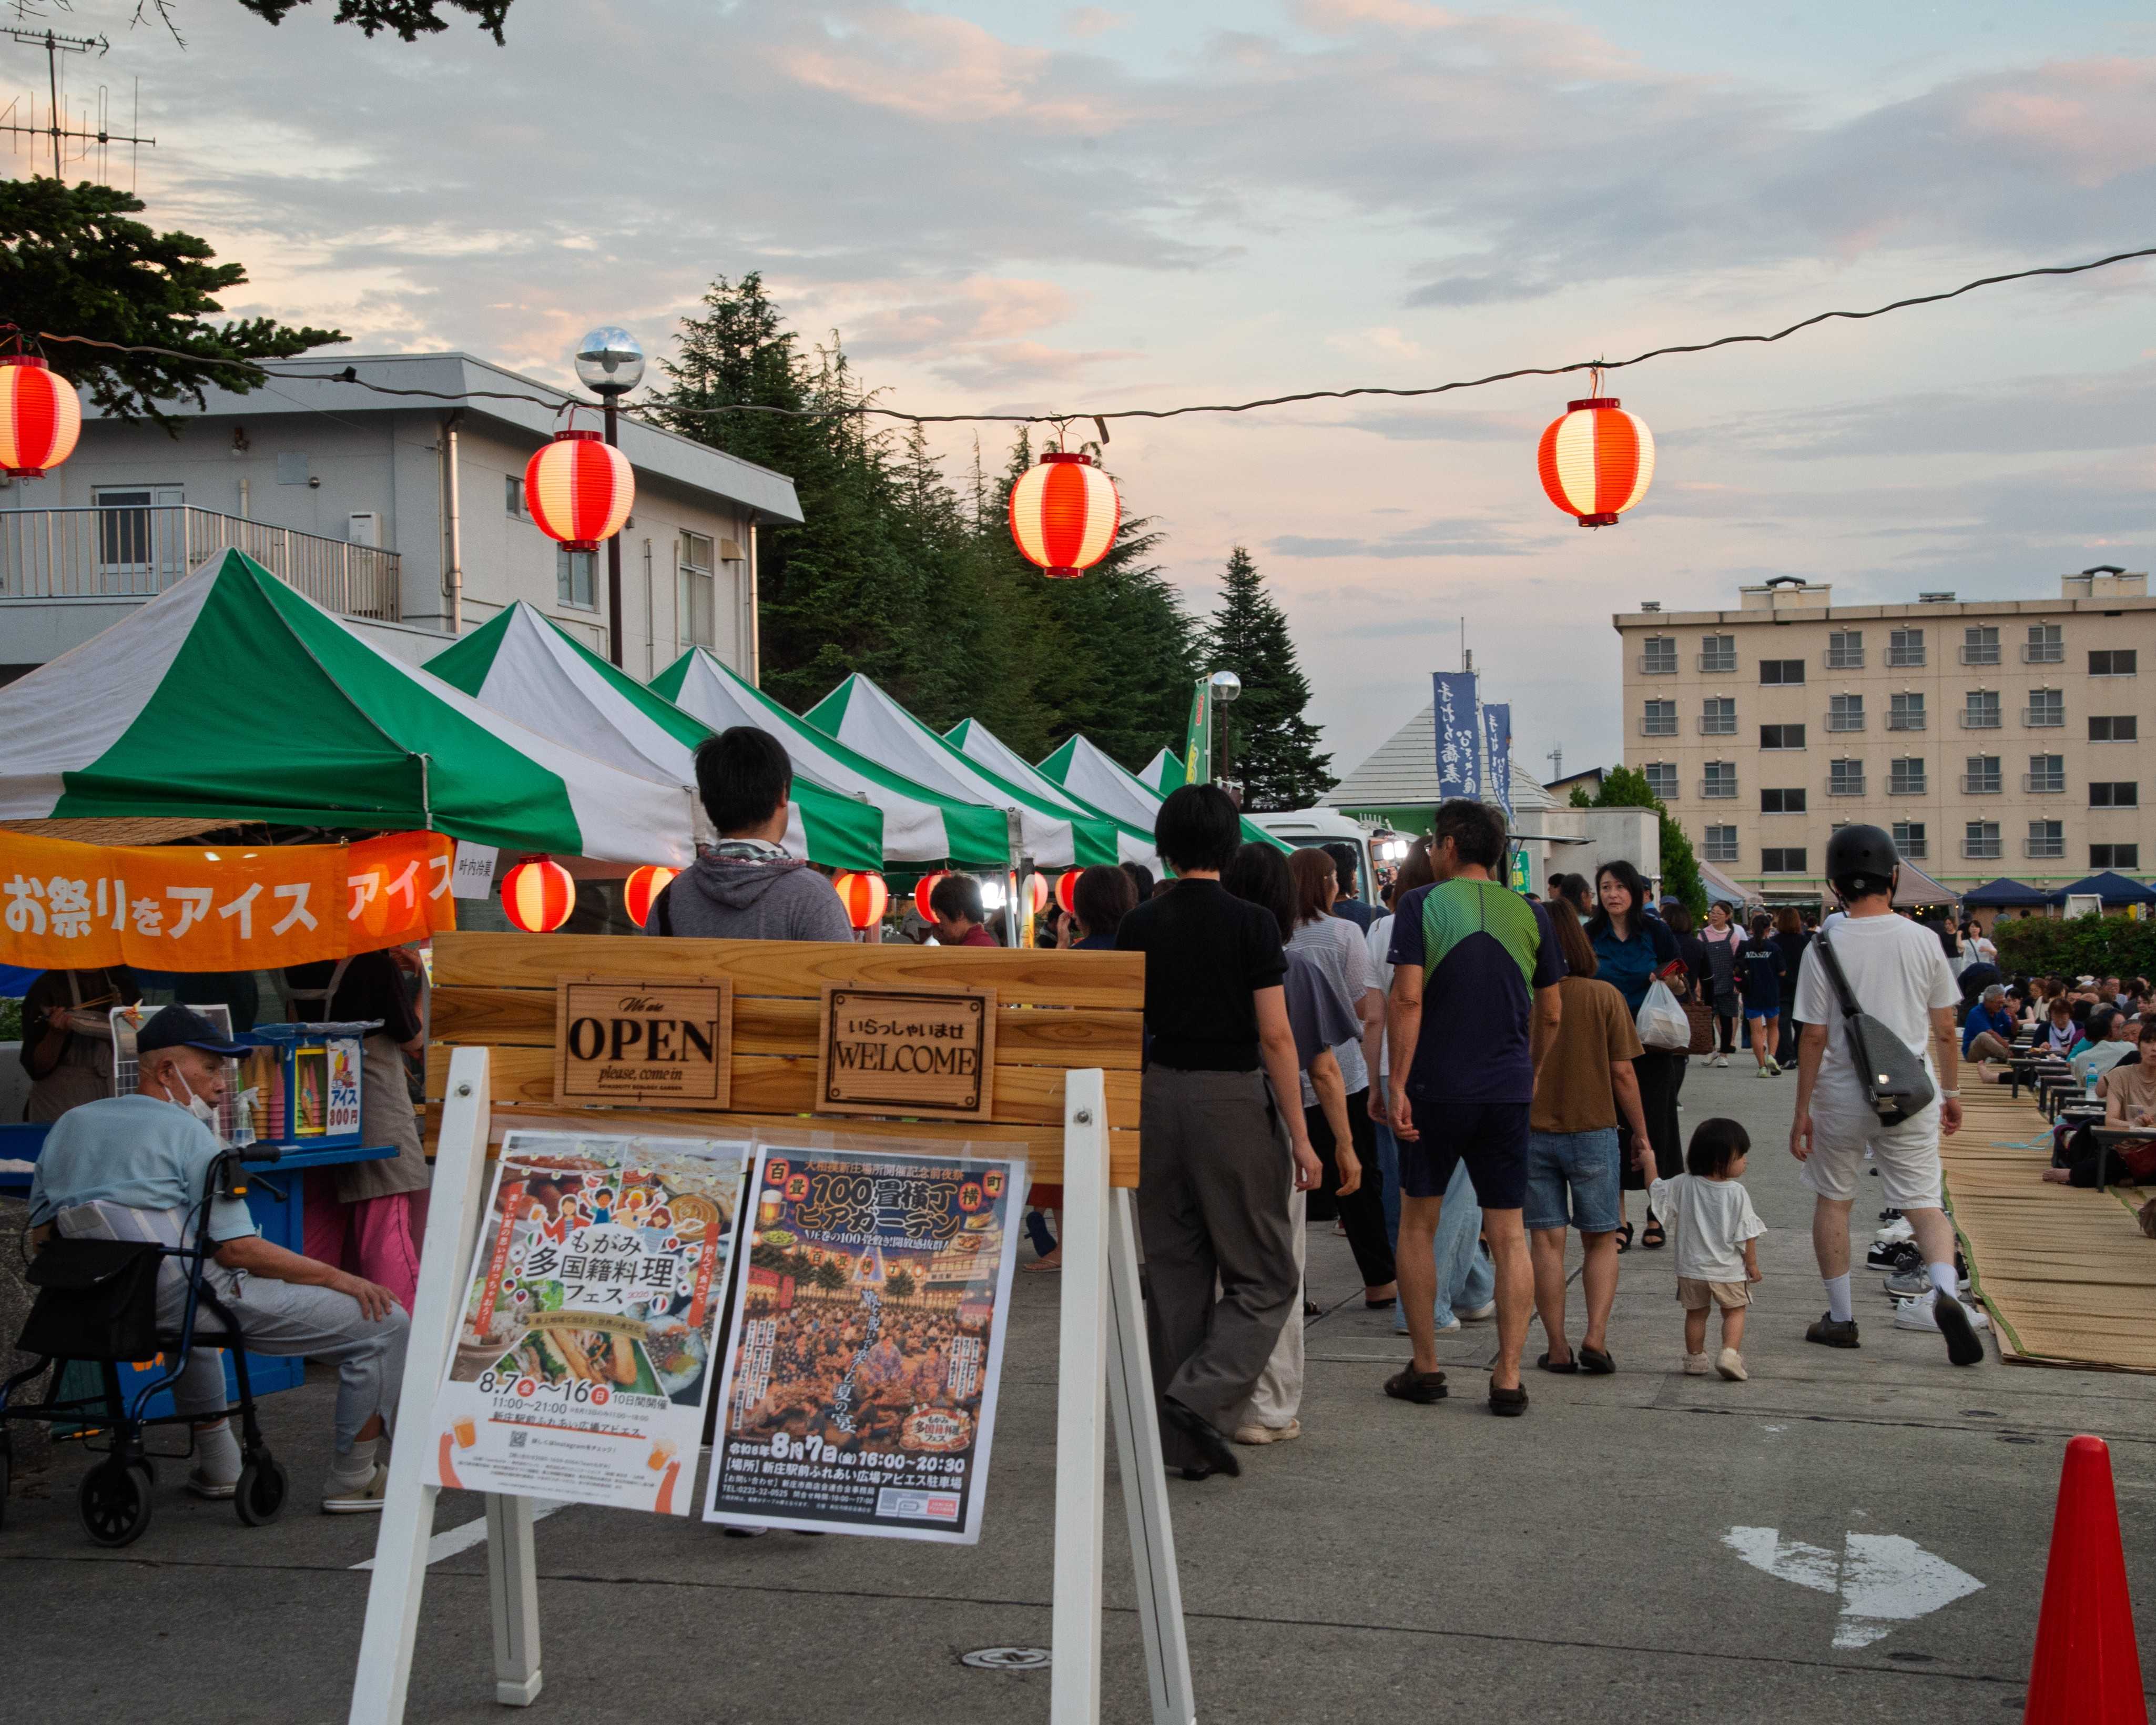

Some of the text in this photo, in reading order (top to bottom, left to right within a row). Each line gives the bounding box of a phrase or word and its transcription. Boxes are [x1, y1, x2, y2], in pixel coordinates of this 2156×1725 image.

[348, 855, 454, 921] アイス
[3, 874, 319, 940] お祭りをアイス
[619, 997, 654, 1012] We
[569, 1017, 718, 1063] OPEN
[849, 1019, 964, 1039] いらっしゃいませ
[835, 1041, 976, 1076] WELCOME
[598, 1065, 682, 1082] please, come in
[331, 1089, 358, 1107] アイス
[770, 1163, 787, 1179] 百
[804, 1160, 963, 1181] 大相撲新庄場所開催記念前夜祭
[812, 1174, 958, 1210] 100畳横丁
[962, 1175, 1002, 1206] 横 町
[796, 1203, 961, 1240] ビアガーデン
[571, 1231, 642, 1256] もがみ
[526, 1246, 676, 1288] 多国籍料理
[565, 1284, 624, 1304] フェス
[613, 1394, 668, 1411] 10日間開催
[493, 1410, 641, 1436] 新庄駅前ふれあい広場アビエス
[927, 1415, 949, 1425] もがみ
[926, 1434, 945, 1443] フェス
[762, 1462, 962, 1489] 新庄駅前ふれあい広場アビエス駐車場
